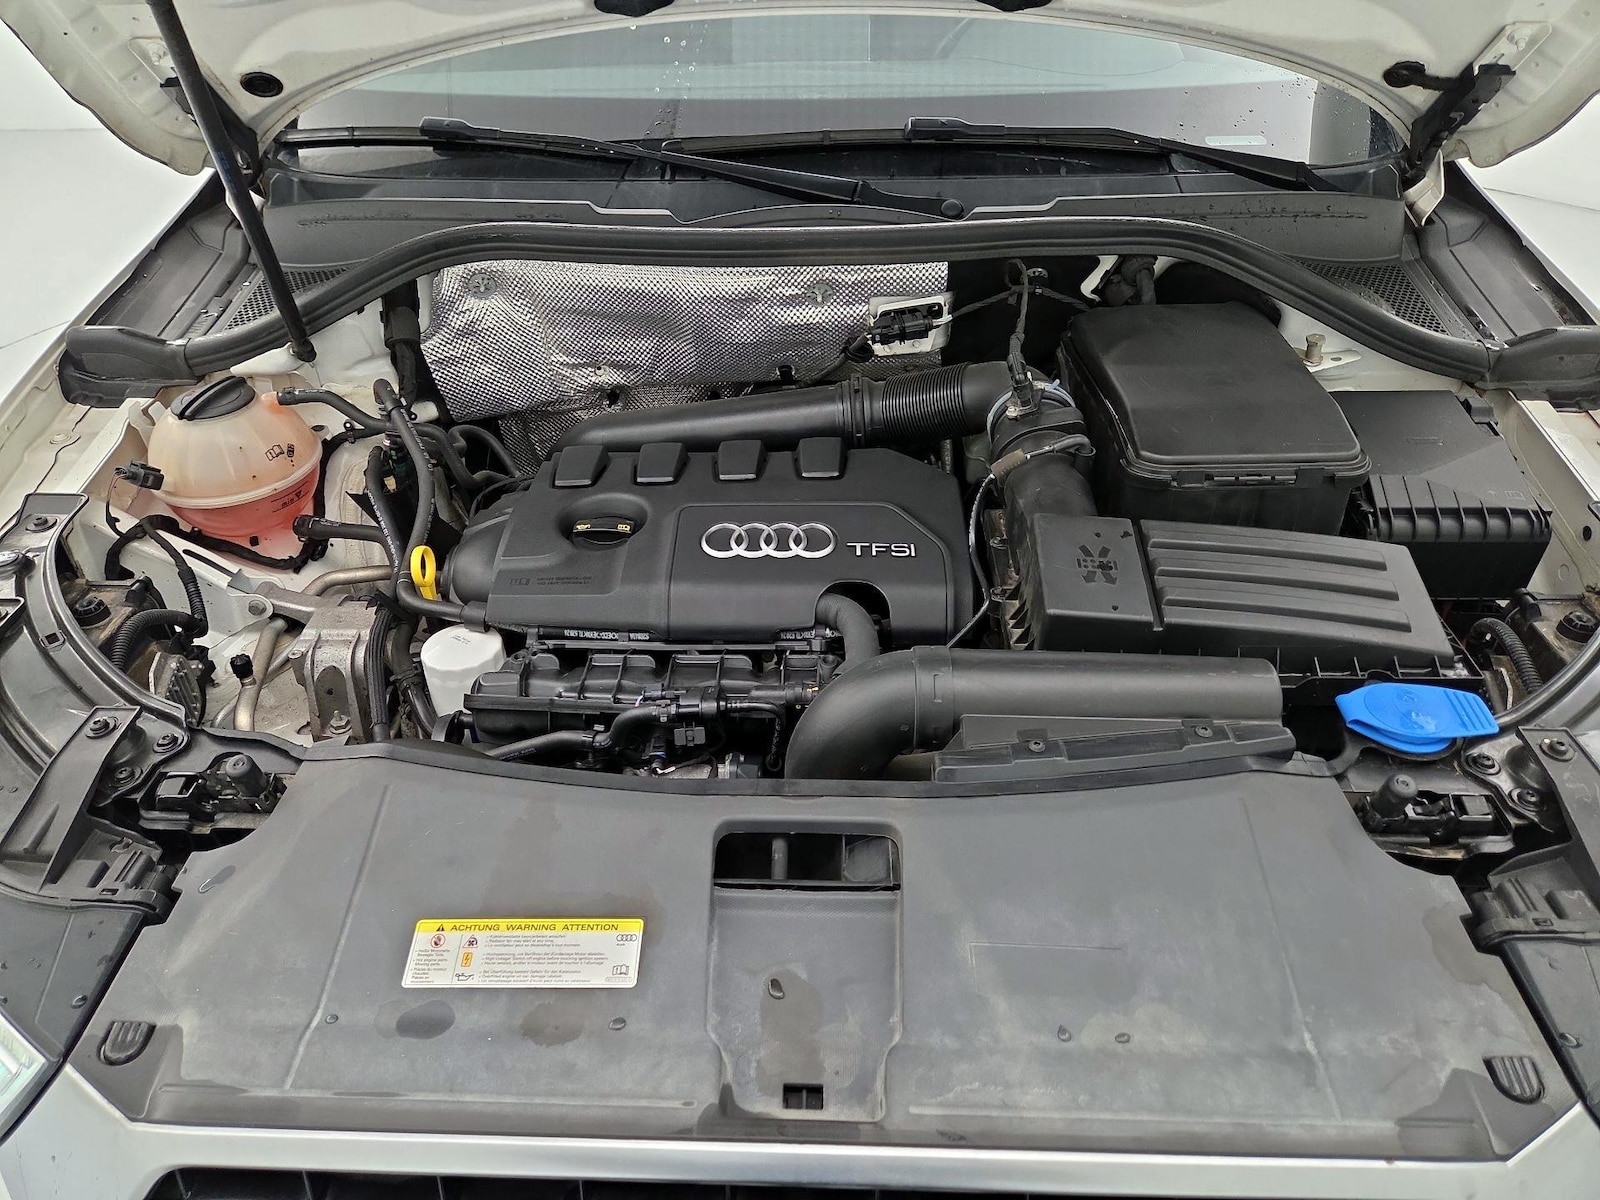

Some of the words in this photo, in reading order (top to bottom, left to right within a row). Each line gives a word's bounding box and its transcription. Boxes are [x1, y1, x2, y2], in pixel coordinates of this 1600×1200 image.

[846, 542, 916, 557] TFSI
[450, 924, 500, 932] ACHTUNG
[506, 923, 556, 931] WARNING
[562, 923, 619, 931] ATTENTION
